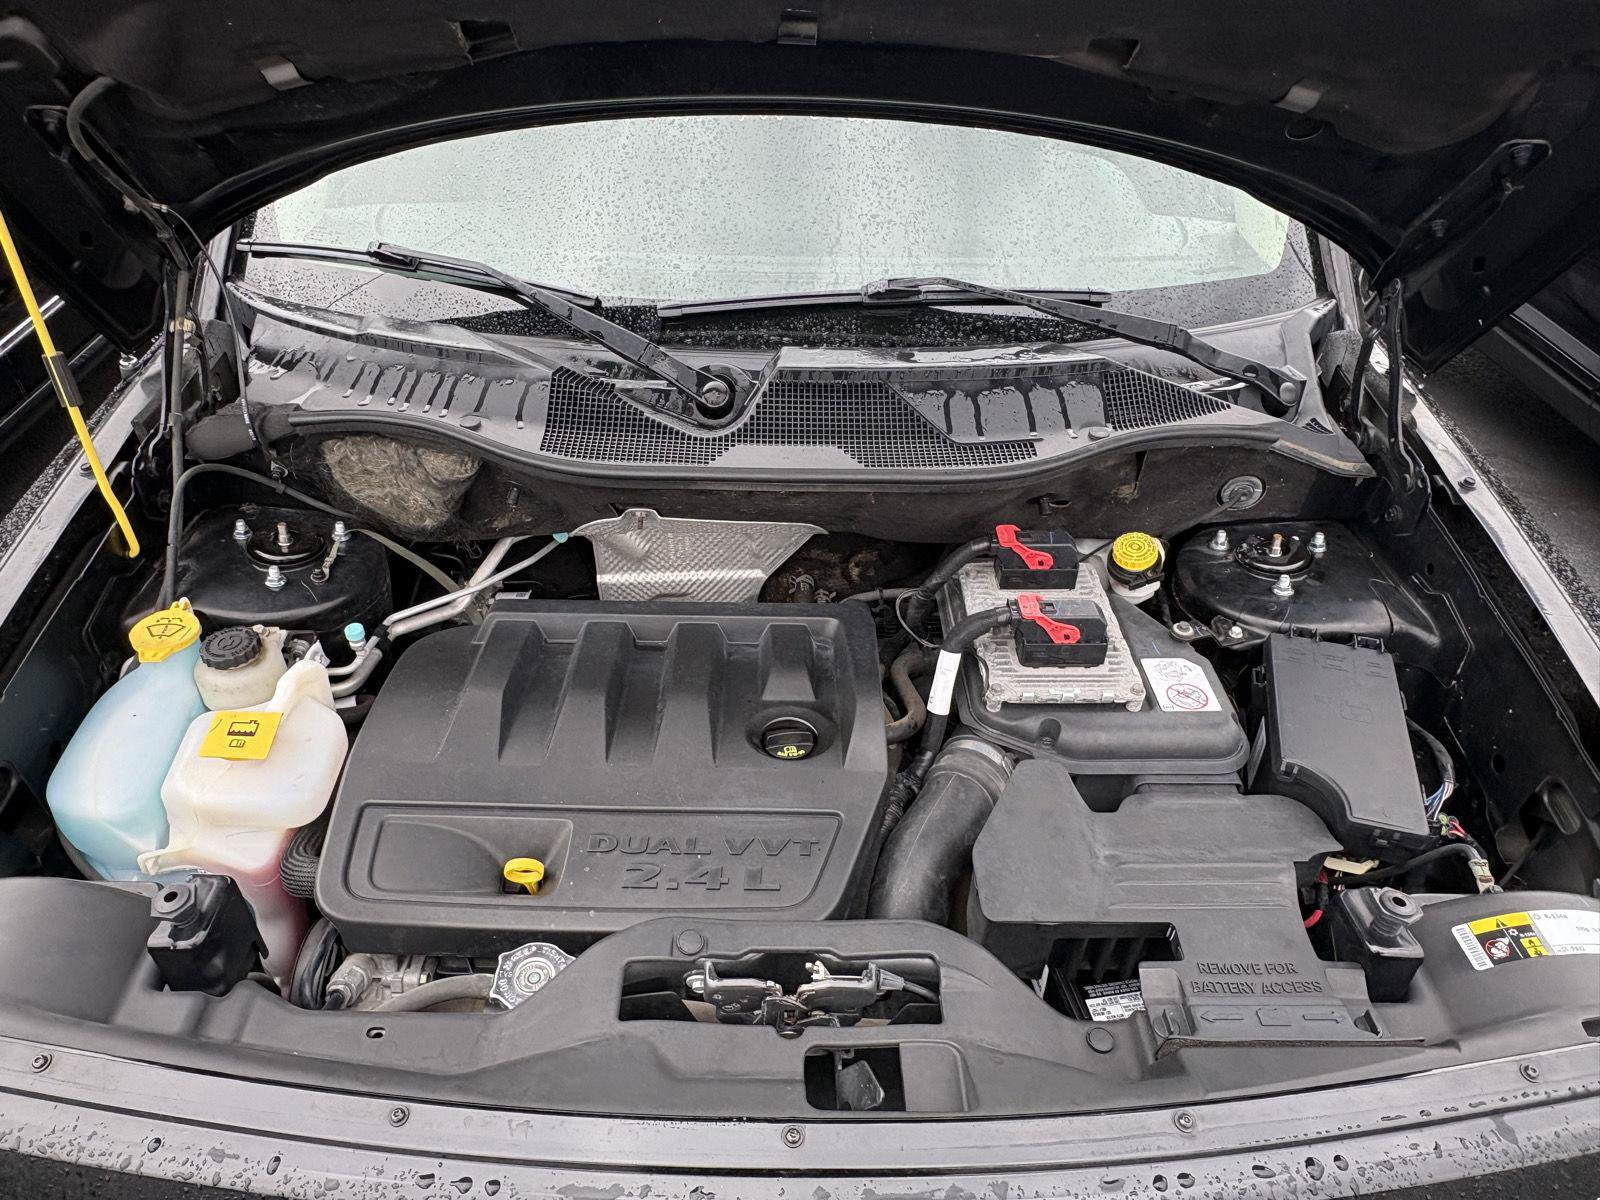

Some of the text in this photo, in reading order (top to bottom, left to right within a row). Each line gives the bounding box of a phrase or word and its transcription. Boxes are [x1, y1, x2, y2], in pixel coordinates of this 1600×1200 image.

[586, 833, 820, 857] DUAL VVT
[1196, 961, 1299, 976] REMOVE FOR
[1190, 980, 1324, 995] BATTERY ACCESS
